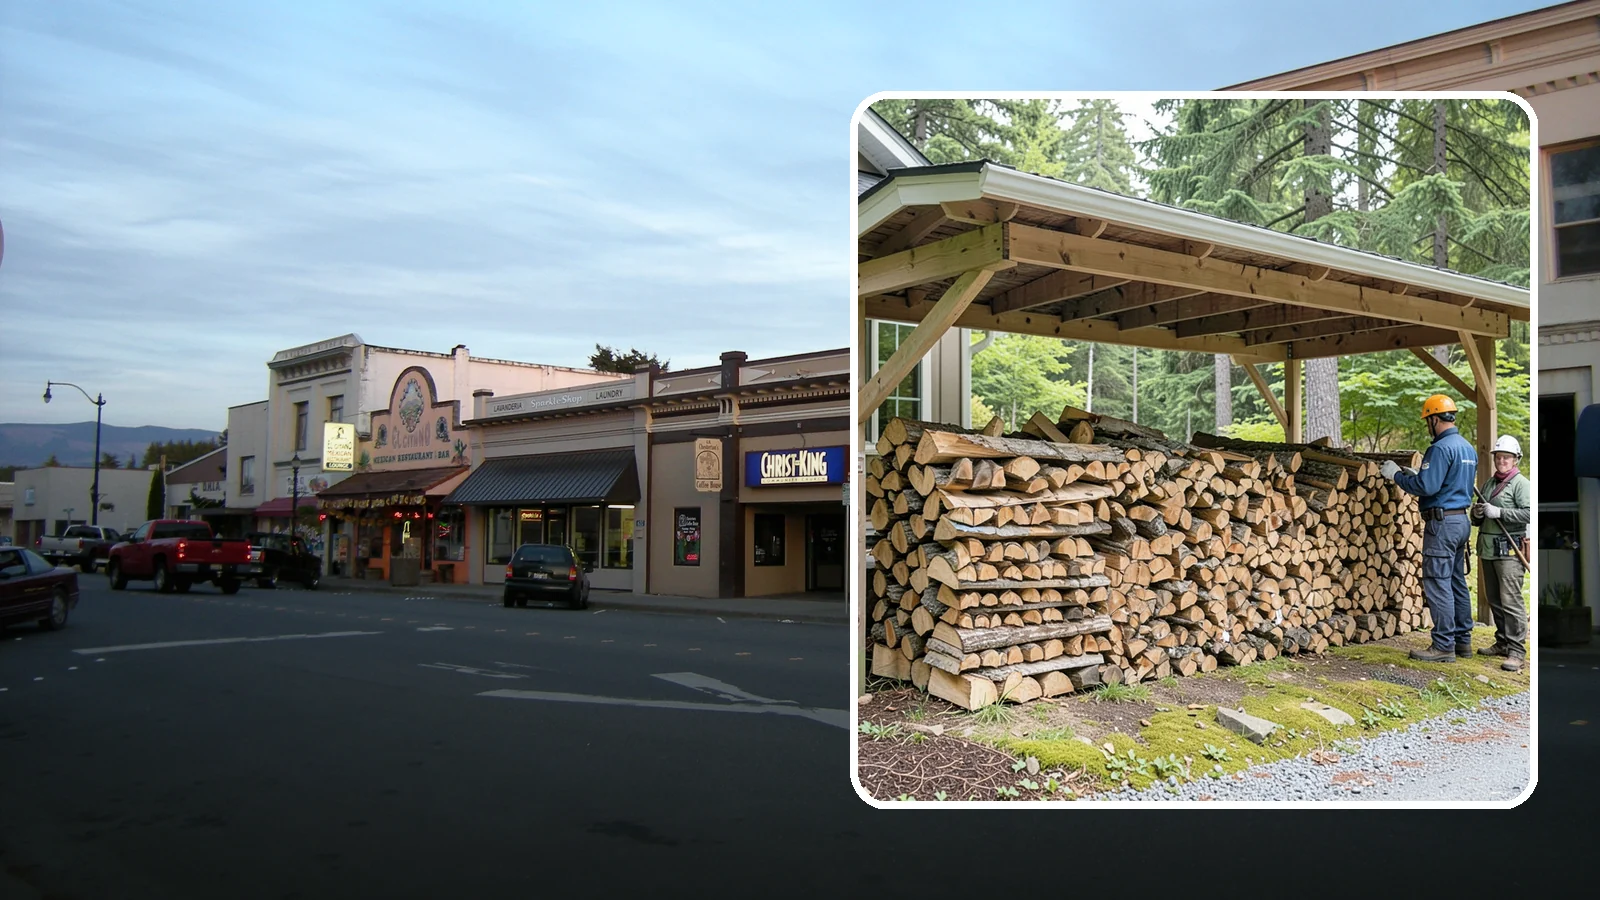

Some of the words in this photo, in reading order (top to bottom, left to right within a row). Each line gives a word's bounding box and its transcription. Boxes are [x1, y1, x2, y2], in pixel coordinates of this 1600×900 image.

[493, 402, 523, 412] LAVANDERIA
[531, 397, 561, 409] Sparkle
[562, 395, 582, 404] Shop
[596, 389, 623, 399] LAUNDRY
[373, 455, 396, 464] MEXICAN
[397, 452, 433, 462] RESTAURANT
[437, 450, 450, 458] BAR
[761, 452, 797, 477] CHRIST
[799, 450, 827, 476] KING
